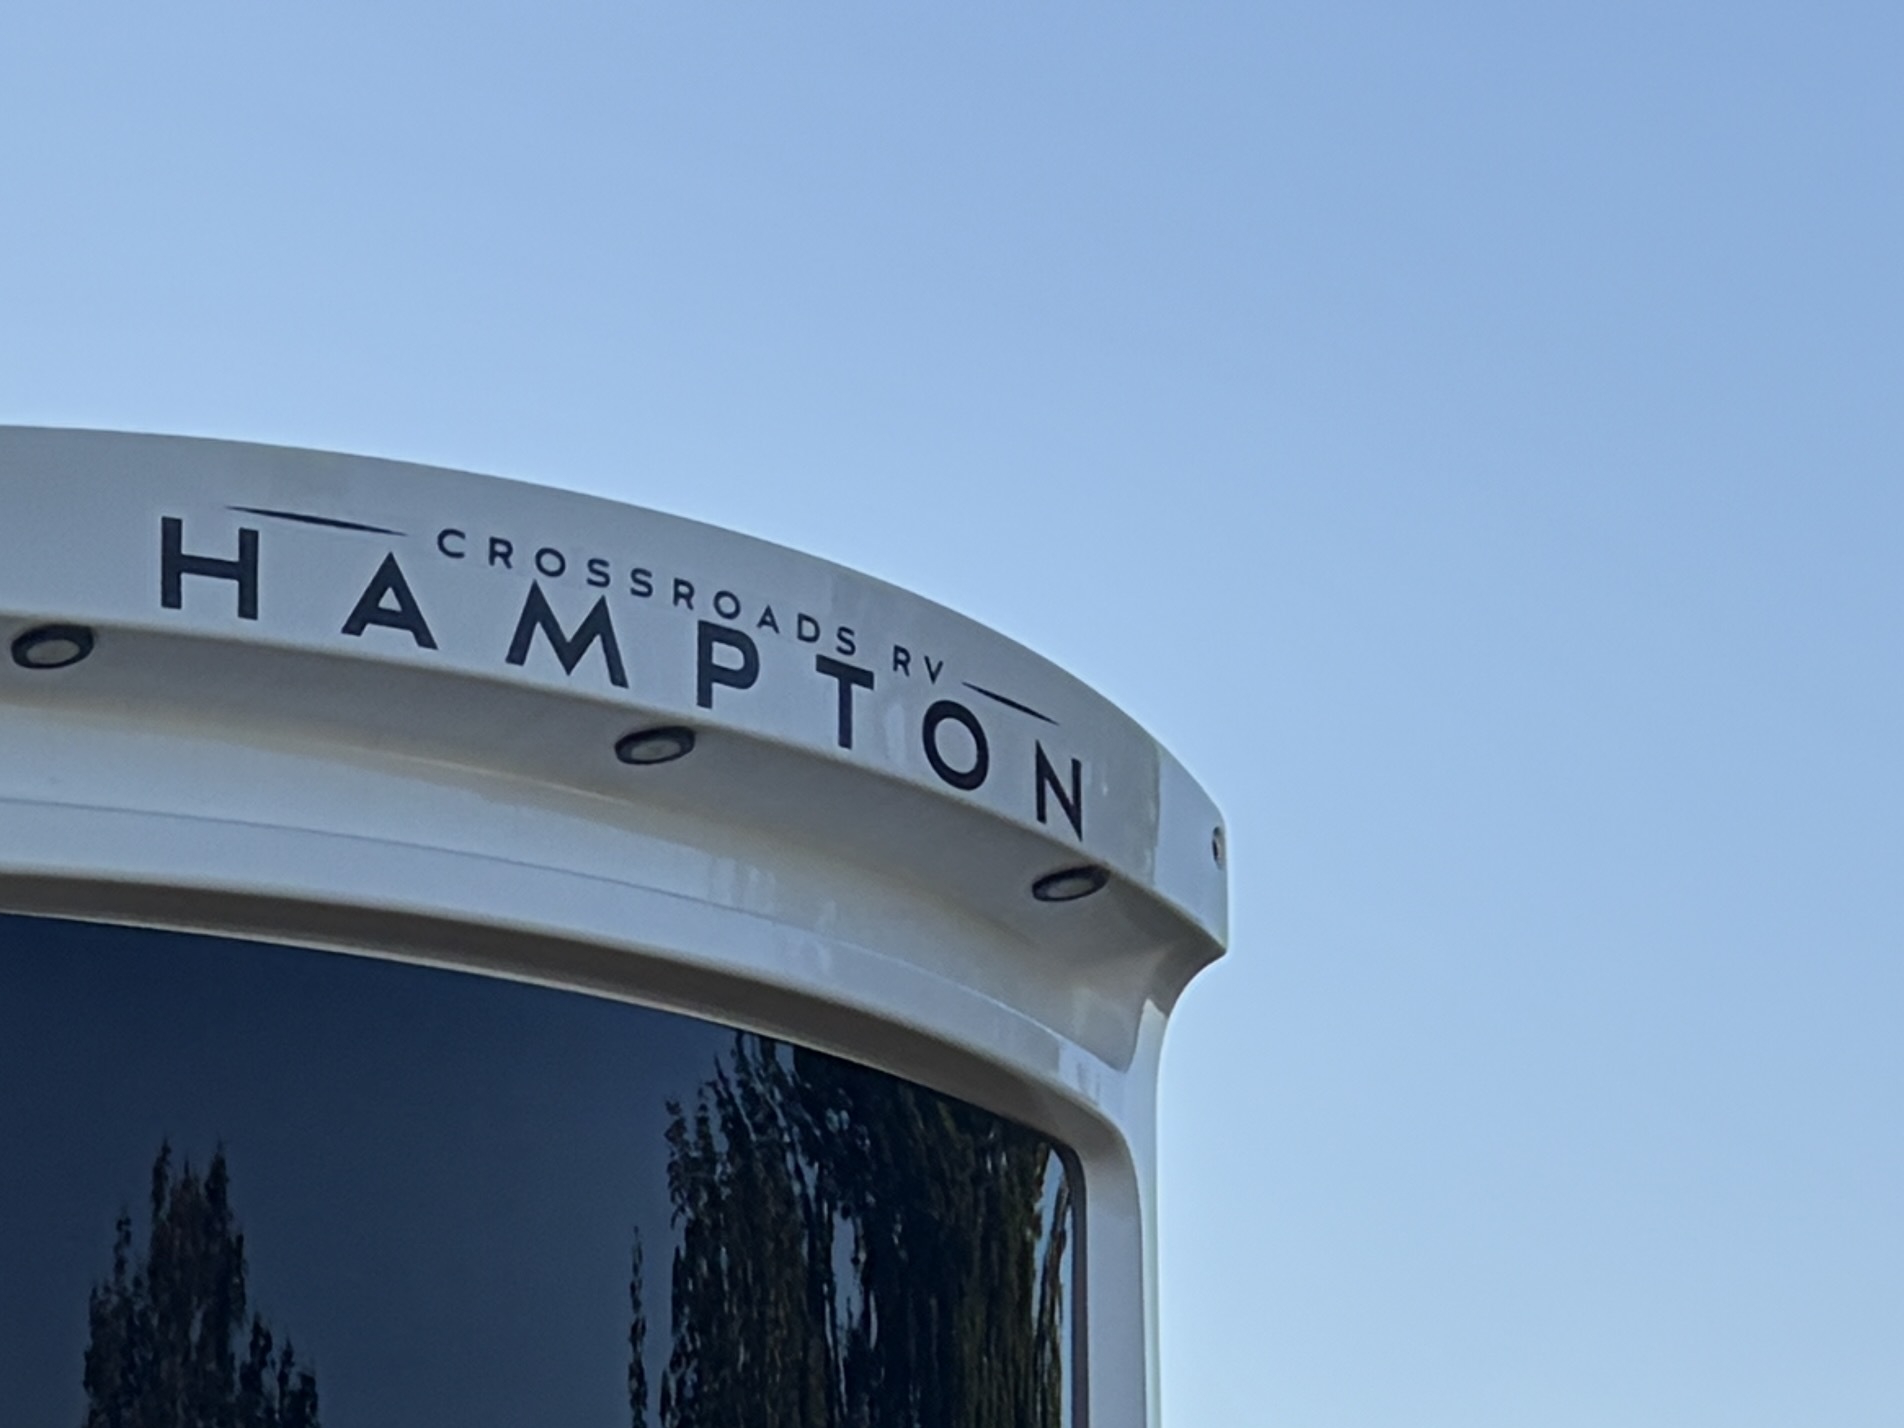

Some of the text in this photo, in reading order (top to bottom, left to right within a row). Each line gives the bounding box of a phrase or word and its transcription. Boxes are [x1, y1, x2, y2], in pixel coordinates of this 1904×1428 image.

[159, 516, 1083, 842] HAMPTON
[436, 527, 945, 685] CROSSROADS RV
